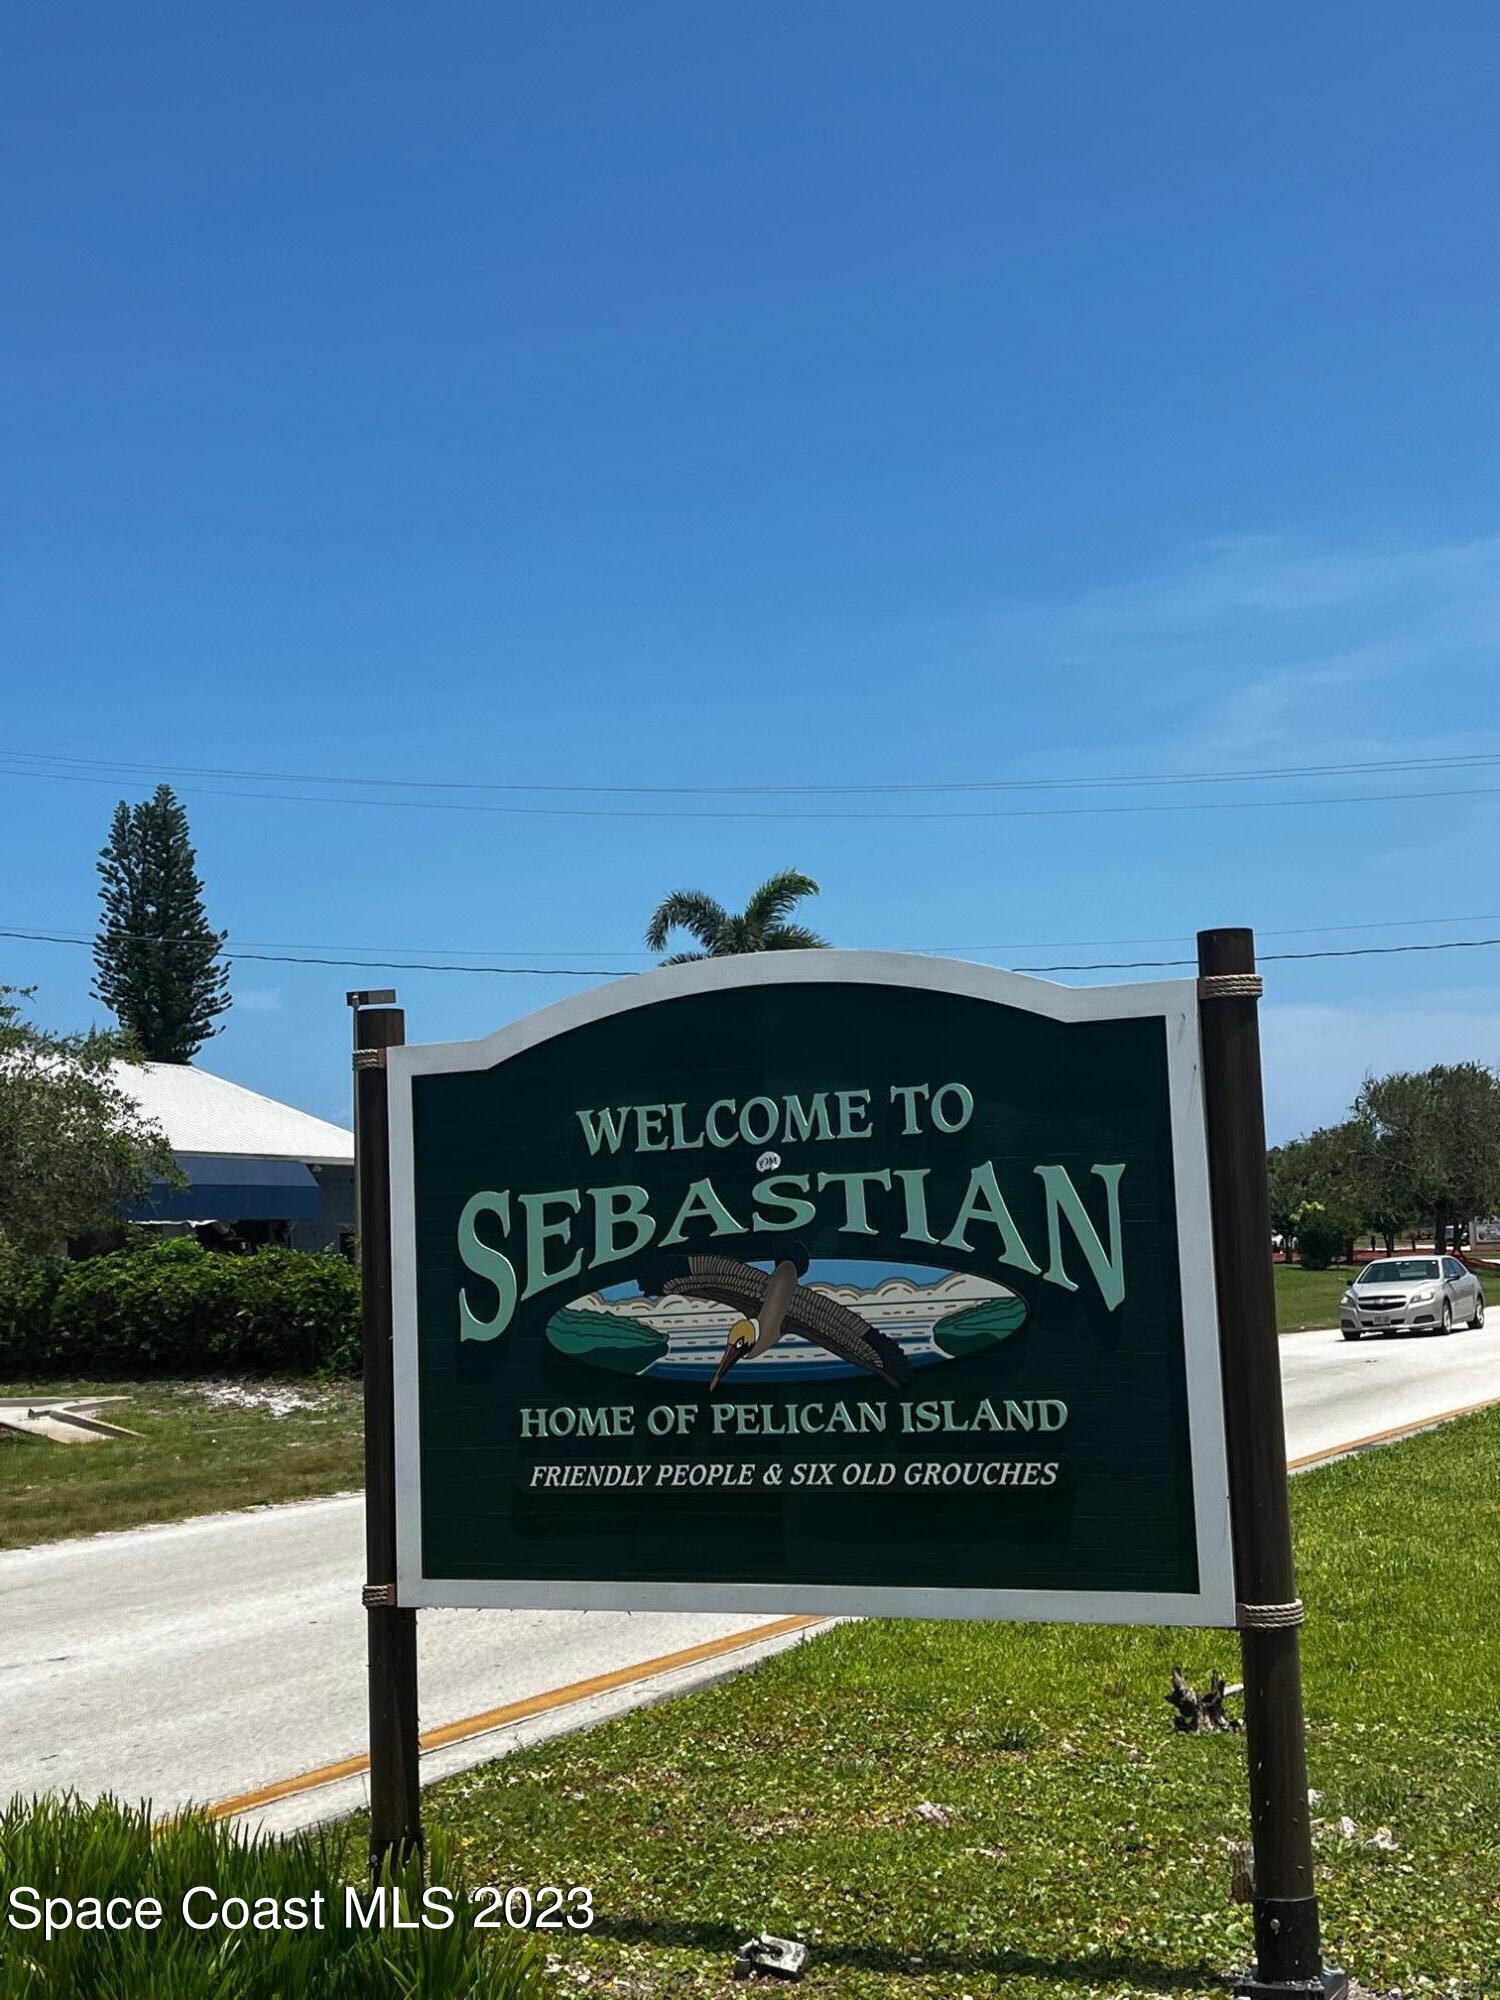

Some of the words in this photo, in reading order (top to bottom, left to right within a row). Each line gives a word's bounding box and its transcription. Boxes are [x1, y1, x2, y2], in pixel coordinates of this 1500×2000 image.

[575, 1088, 872, 1156] WELCOME
[890, 1082, 974, 1135] TO
[457, 1160, 1127, 1342] SEBASTIAN
[519, 1405, 636, 1438] HOME
[647, 1404, 699, 1436] OF
[710, 1400, 887, 1434] PELICAN
[899, 1398, 1068, 1433] ISLAND
[529, 1464, 652, 1487] FRIENDLY
[654, 1463, 756, 1487] PEOPLE
[762, 1463, 784, 1486] &
[789, 1463, 835, 1486] SIX
[842, 1462, 897, 1486] OLD
[904, 1462, 1059, 1486] GROUCHES
